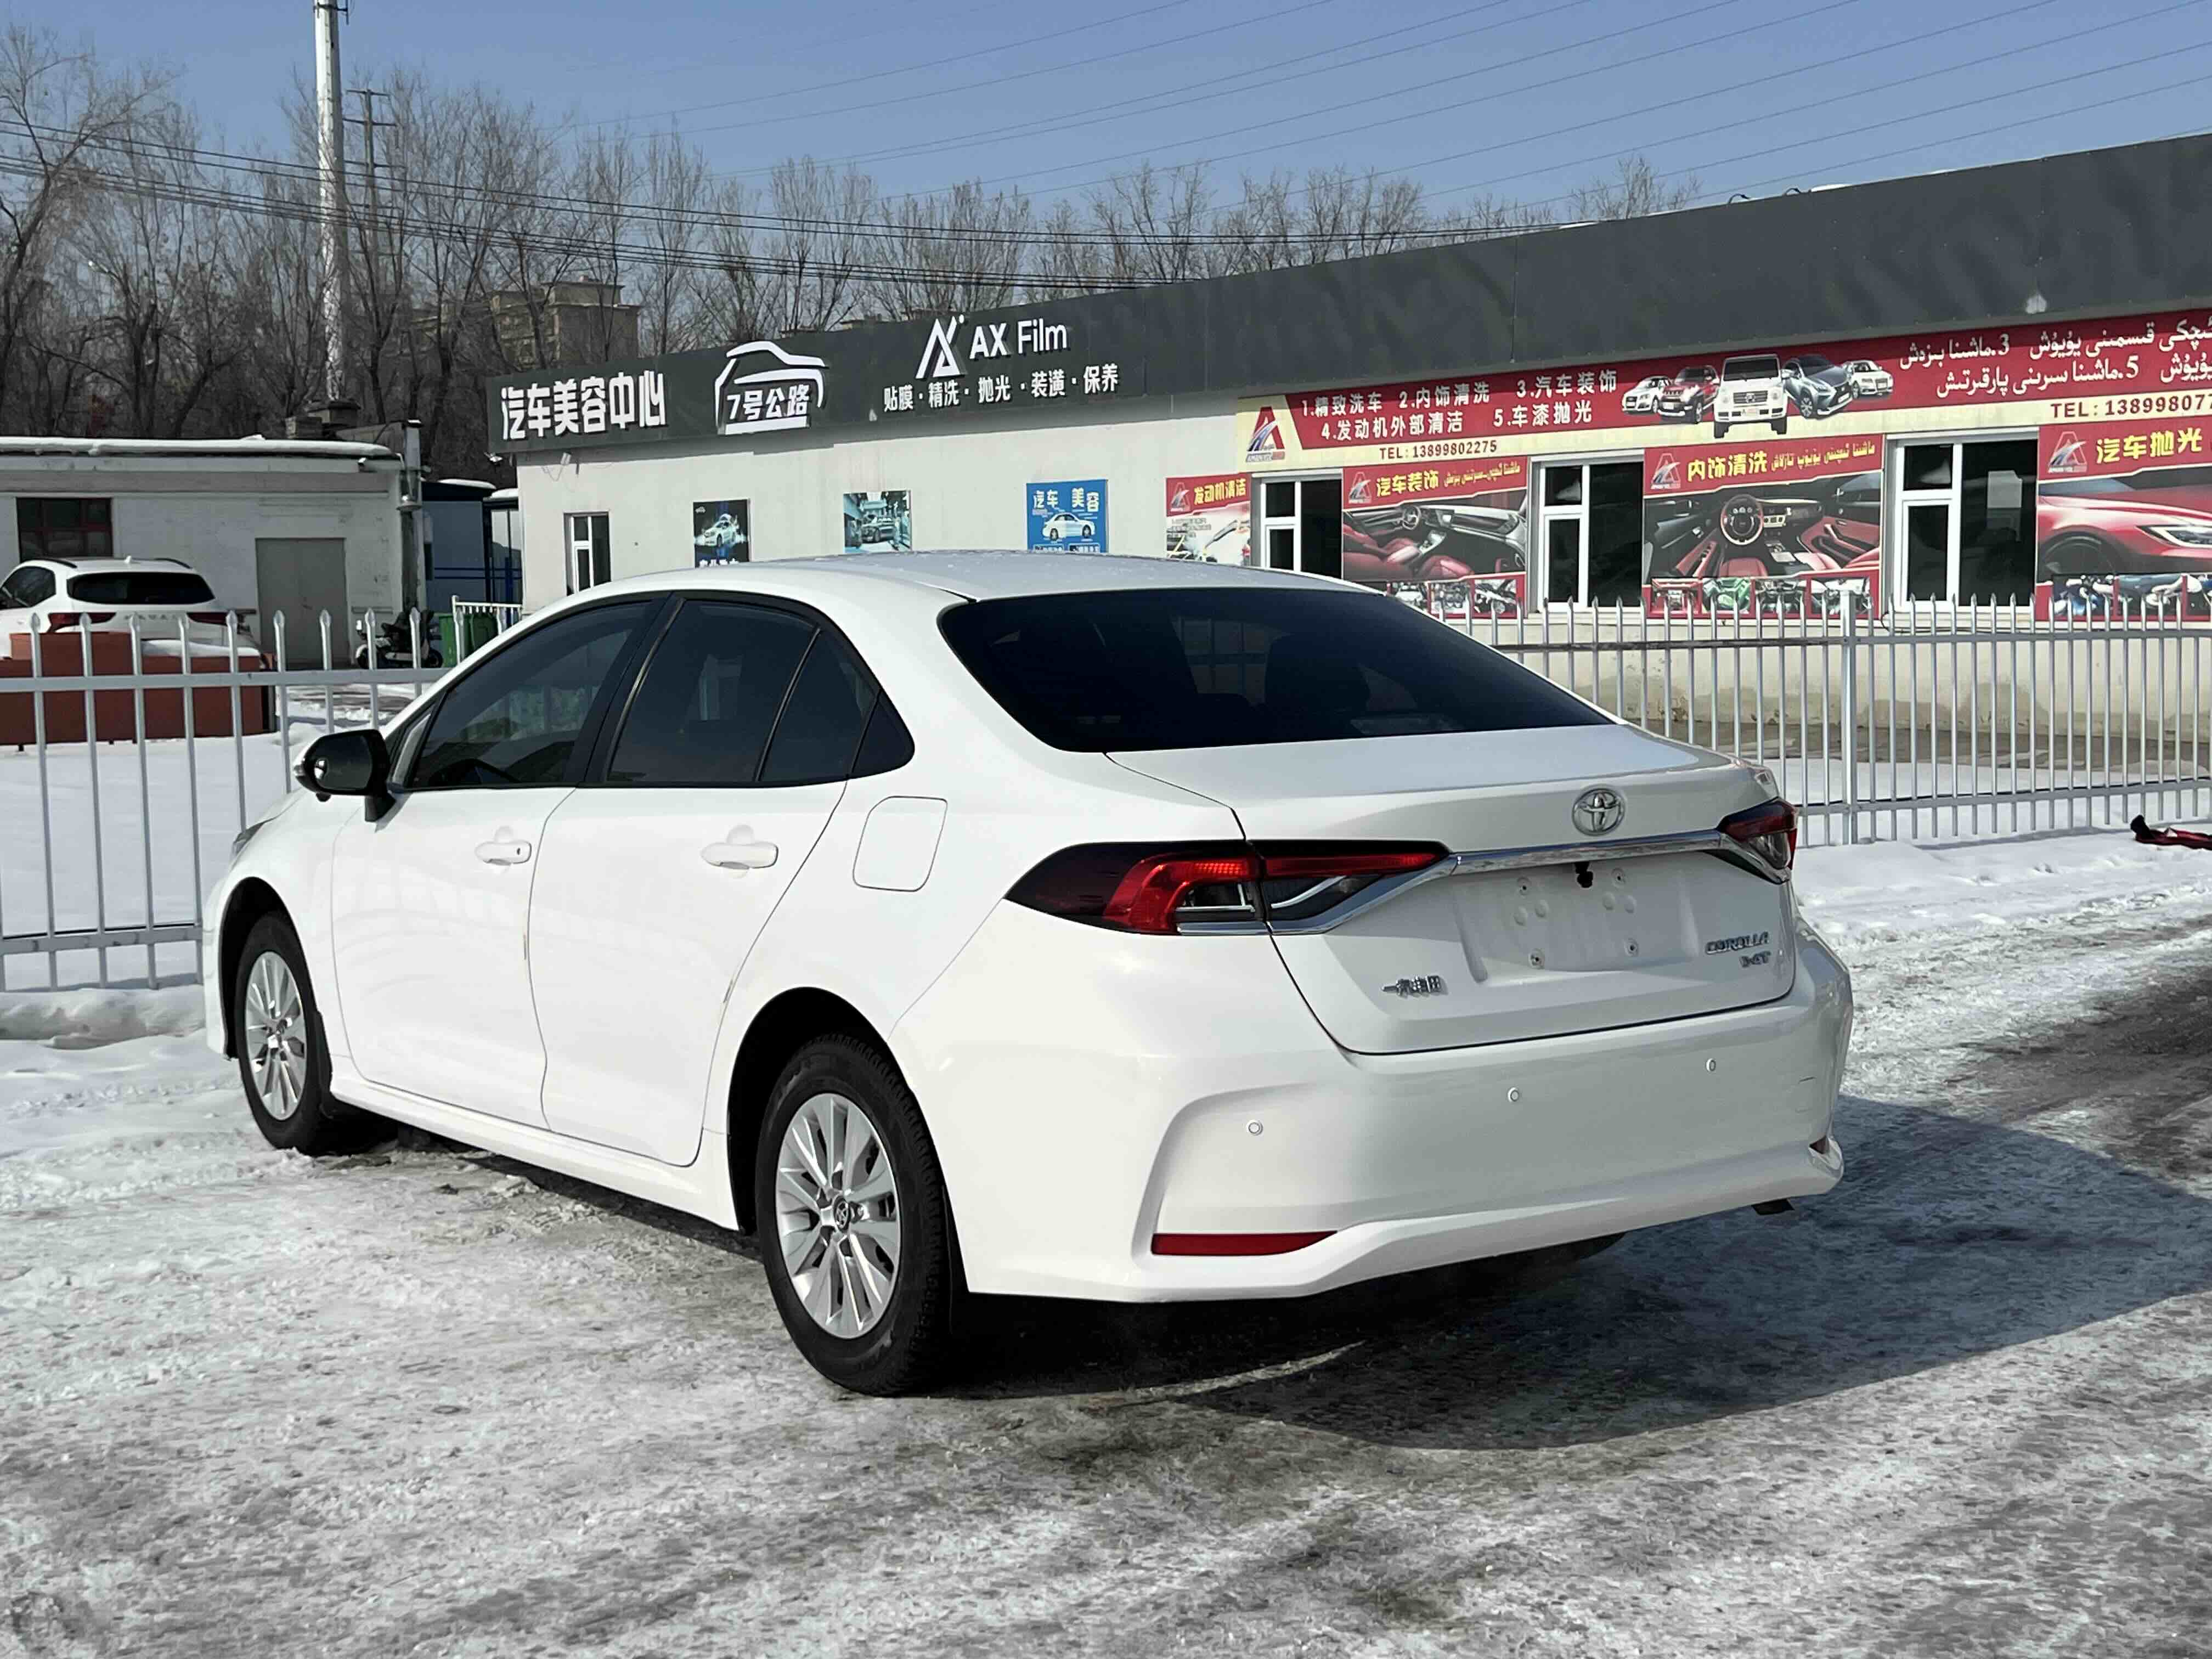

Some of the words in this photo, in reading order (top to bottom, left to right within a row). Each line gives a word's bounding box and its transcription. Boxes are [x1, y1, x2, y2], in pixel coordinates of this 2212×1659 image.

[969, 323, 1008, 359] AX
[1018, 317, 1068, 354] Film
[500, 370, 666, 441] 汽车美容中心
[726, 385, 810, 420] 7号公路
[1400, 381, 1490, 409] 2.内饰清洗
[1516, 369, 1617, 399] 3.汽车装饰
[1322, 410, 1463, 441] 4.发动机外部清洁
[1493, 399, 1592, 428] 5.车漆抛光
[2096, 427, 2202, 464] 汽车抛光
[1375, 470, 1440, 498] 汽车装饰
[1688, 451, 1768, 482] 内饰清洗
[1033, 489, 1058, 509] 汽车
[1071, 487, 1099, 512] 美容
[1193, 478, 1246, 505] 发动机清洁
[1706, 931, 1770, 953] COROLLA
